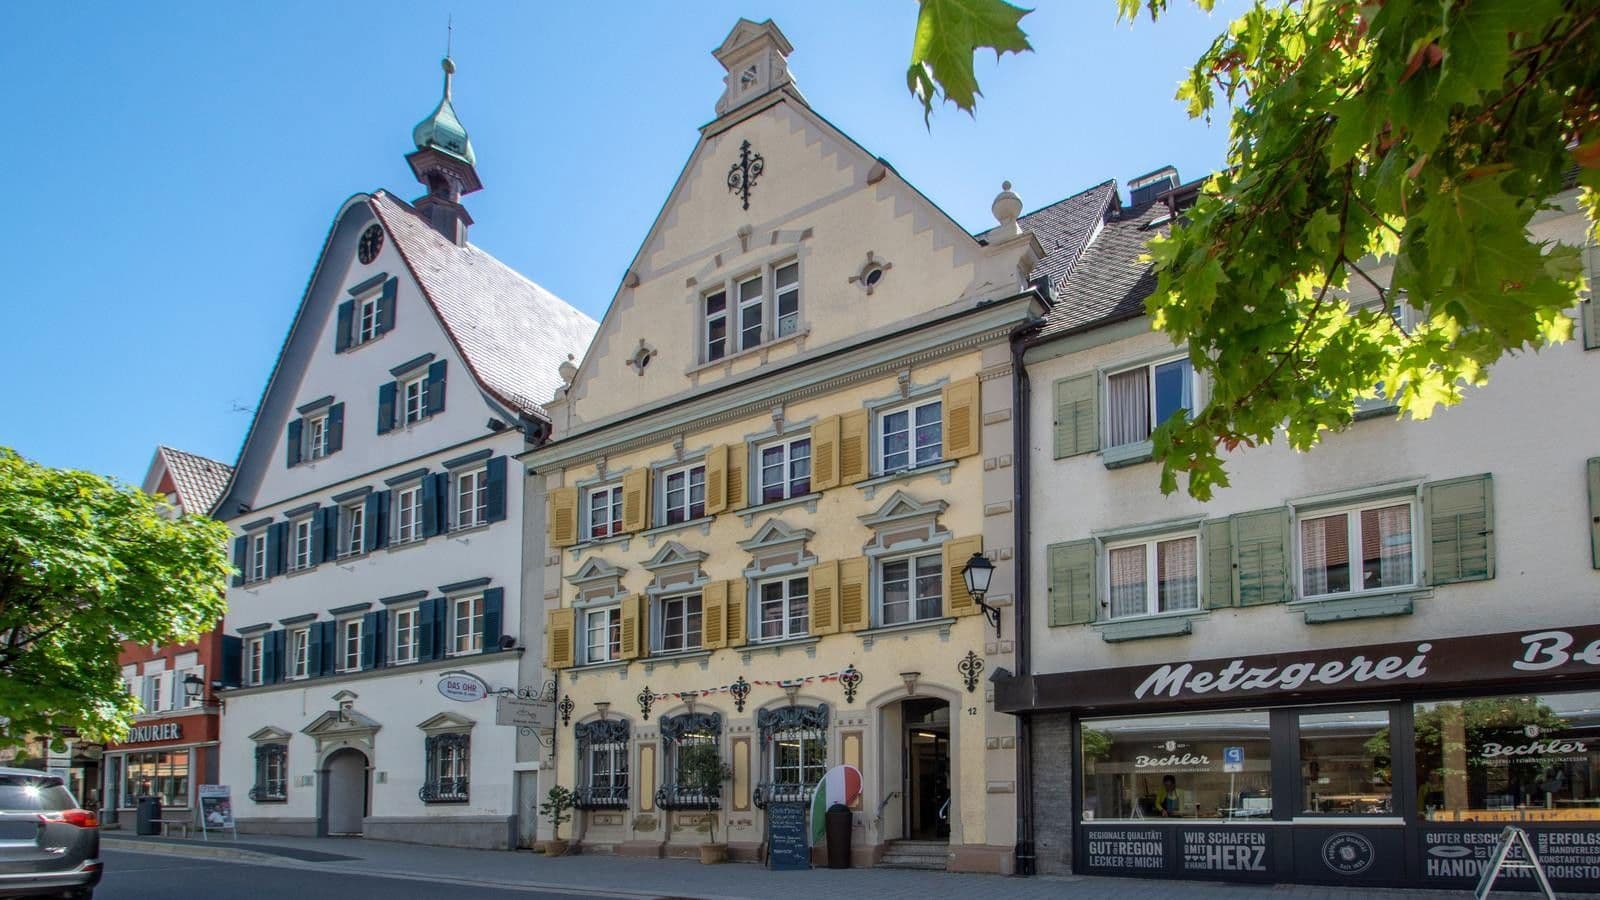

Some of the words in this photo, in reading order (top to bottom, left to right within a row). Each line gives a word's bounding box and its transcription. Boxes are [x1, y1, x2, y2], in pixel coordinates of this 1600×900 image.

[1134, 643, 1433, 700] Metzgerei
[447, 681, 460, 689] DAS
[462, 682, 477, 692] OHR
[967, 706, 977, 716] 12
[123, 723, 180, 744] DKURIER
[1480, 739, 1588, 758] Bechler
[1134, 753, 1210, 768] Bechler
[1088, 831, 1126, 840] REGIONALE
[1127, 830, 1162, 841] QUALITÄT!
[1184, 832, 1206, 844] WIR
[1208, 832, 1266, 845] SCHAFFEN
[1426, 833, 1461, 844] GUTER
[1089, 841, 1112, 855] GUT
[1118, 841, 1163, 856] REGION
[1190, 845, 1206, 854] MIT
[1089, 855, 1124, 867] LECKER
[1134, 857, 1163, 868] MICH!
[1206, 845, 1267, 871] HERZ
[1539, 855, 1580, 865] KONSTANT
